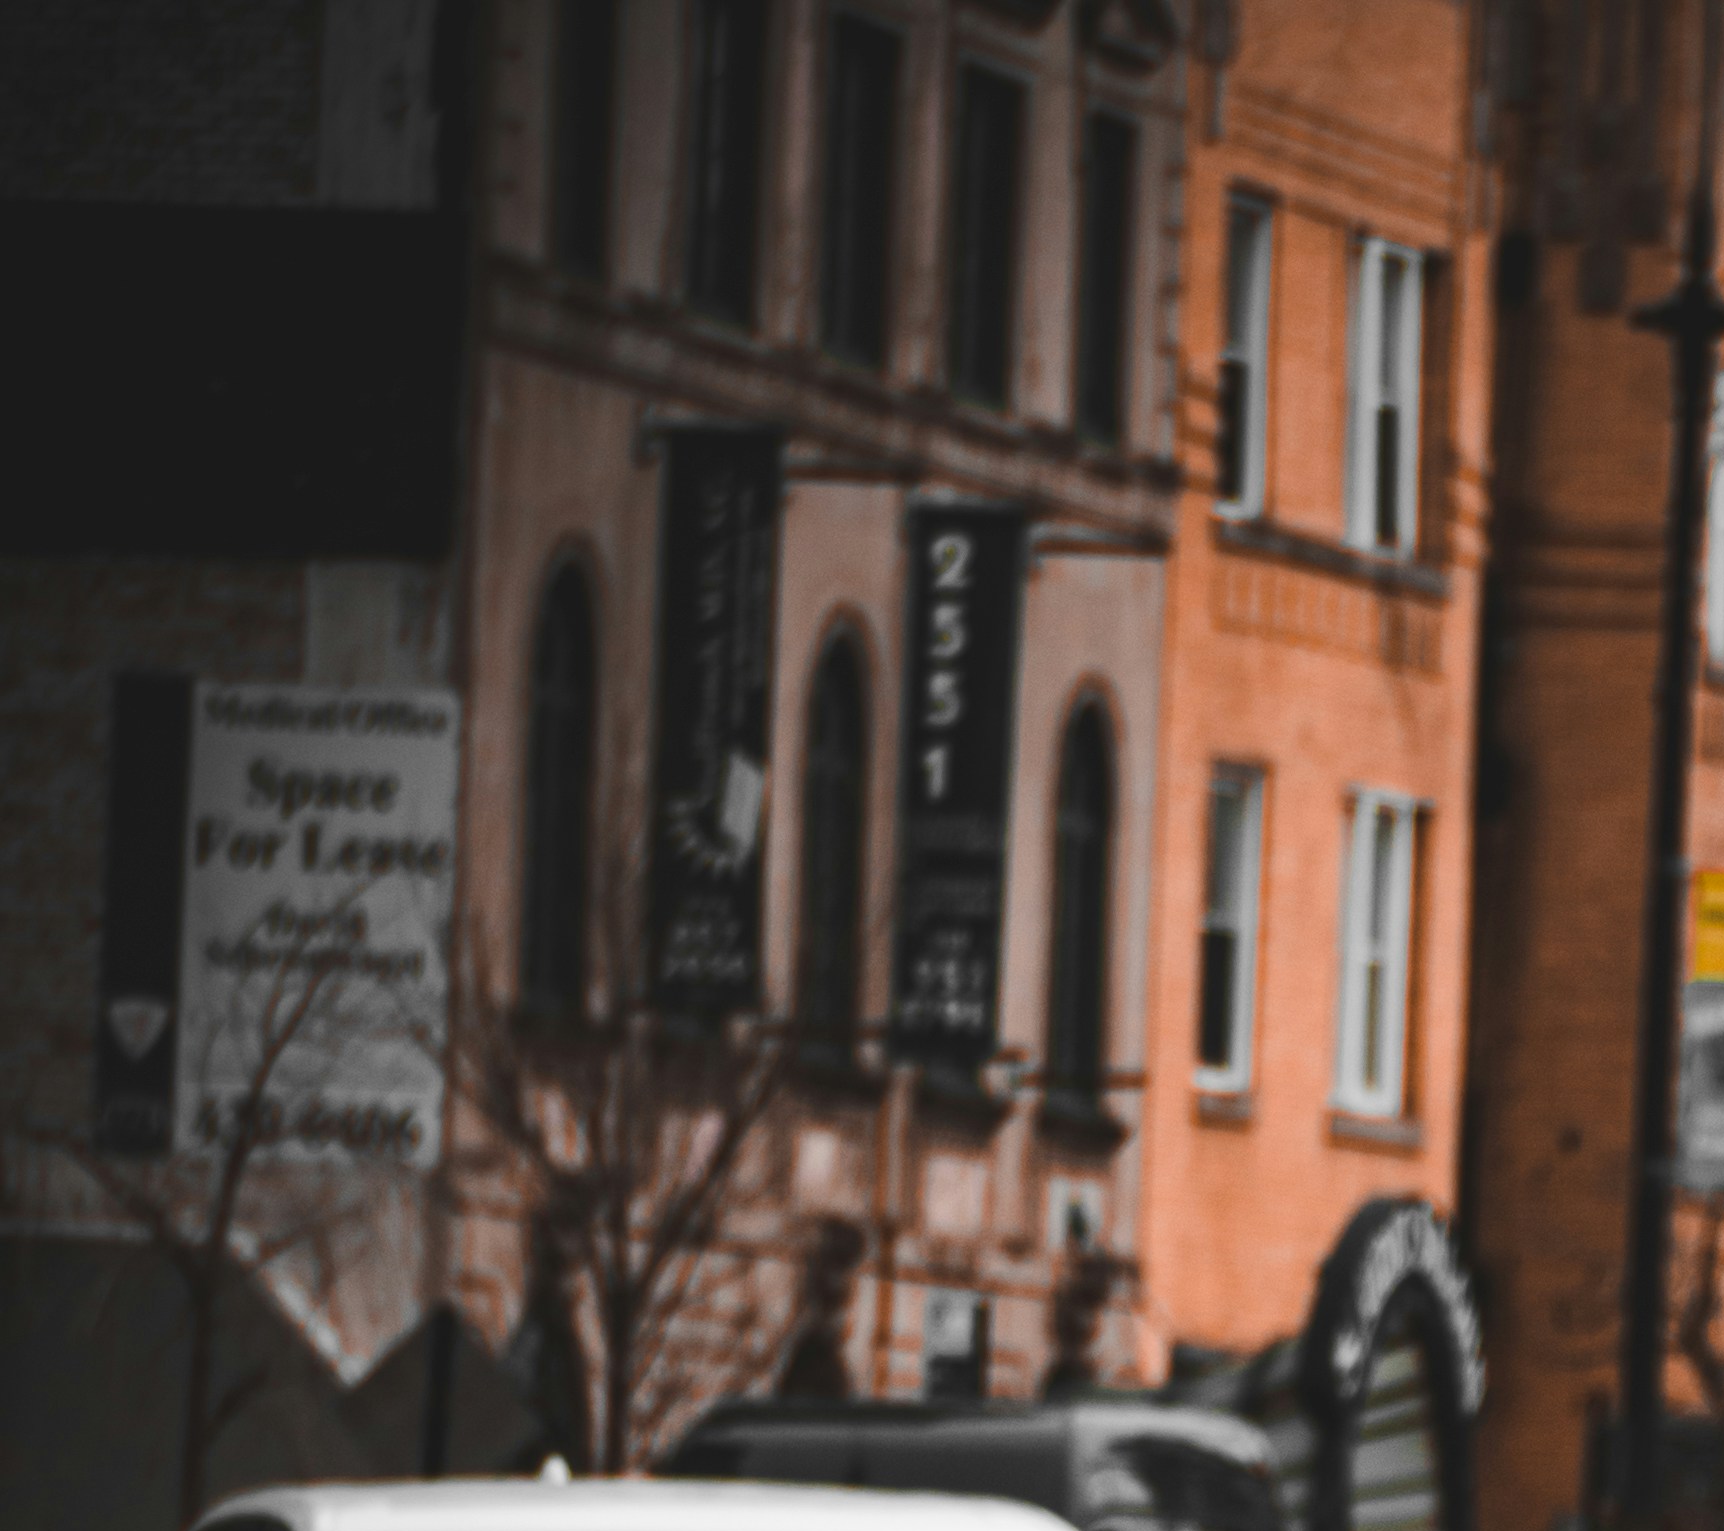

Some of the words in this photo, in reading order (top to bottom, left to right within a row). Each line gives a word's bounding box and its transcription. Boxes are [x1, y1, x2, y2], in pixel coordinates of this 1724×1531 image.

[922, 532, 973, 798] 2551
[249, 758, 399, 819] Space
[197, 818, 284, 869] For
